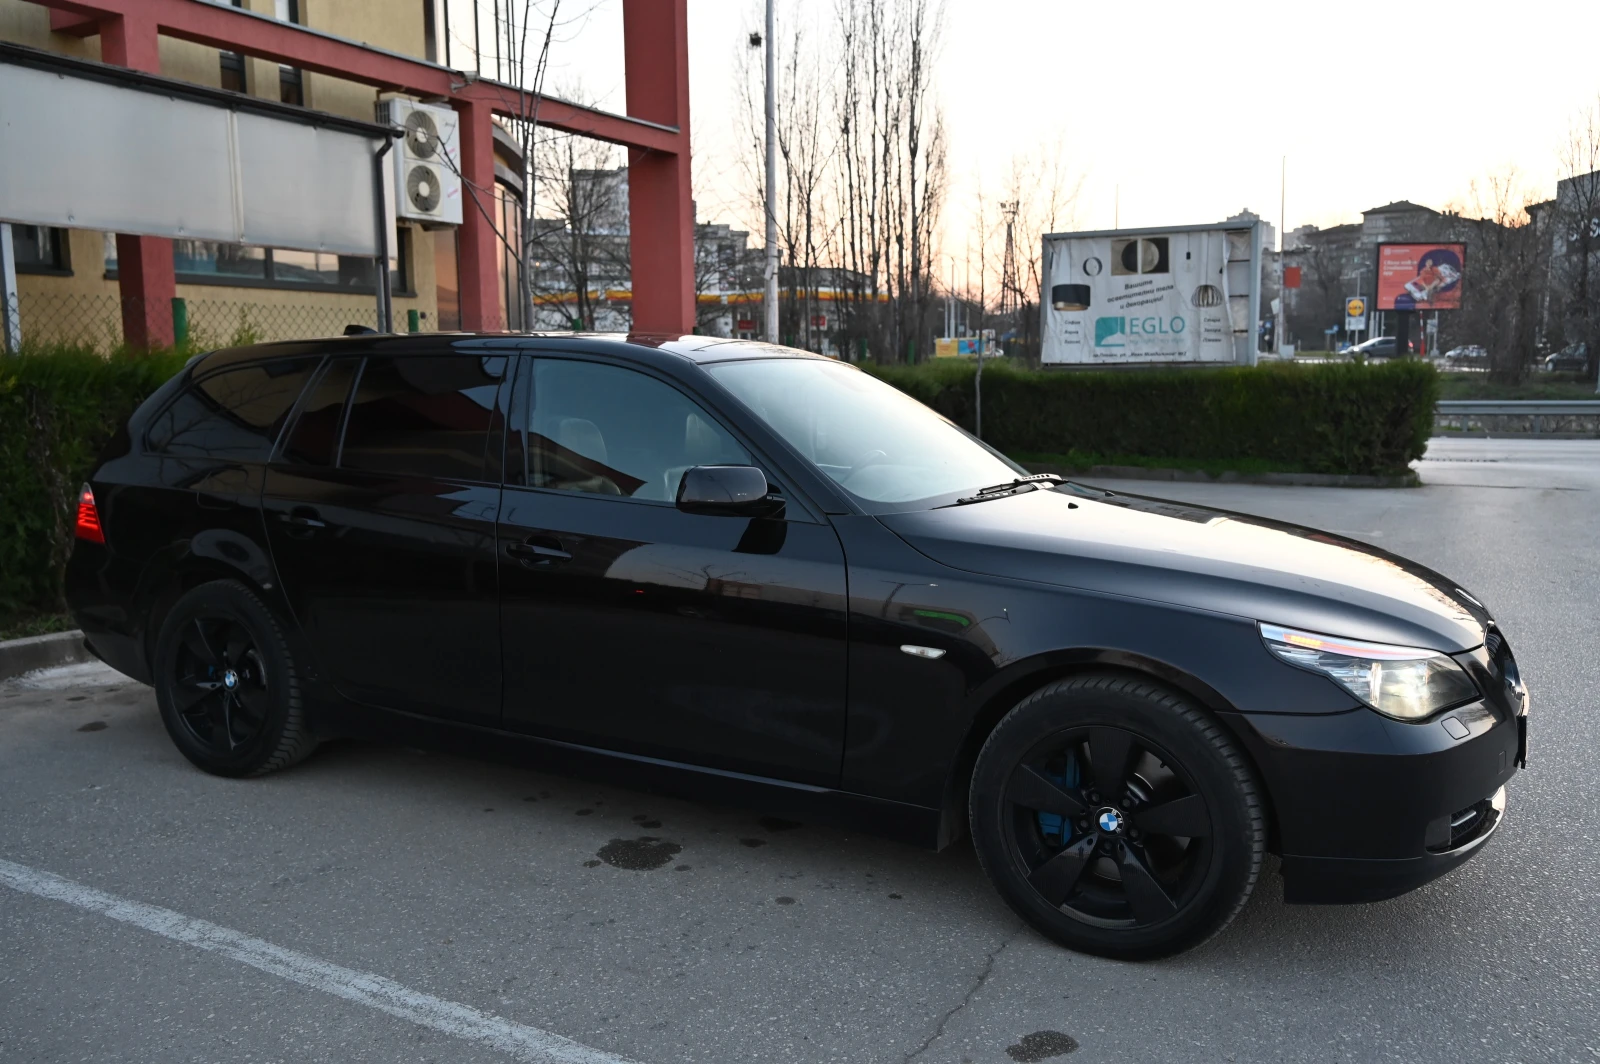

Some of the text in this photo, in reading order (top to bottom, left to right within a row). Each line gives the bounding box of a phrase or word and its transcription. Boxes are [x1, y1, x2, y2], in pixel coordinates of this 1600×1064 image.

[1106, 284, 1174, 303] осветителни тела
[1124, 279, 1153, 290] Вашите
[1129, 316, 1186, 335] EGLO
